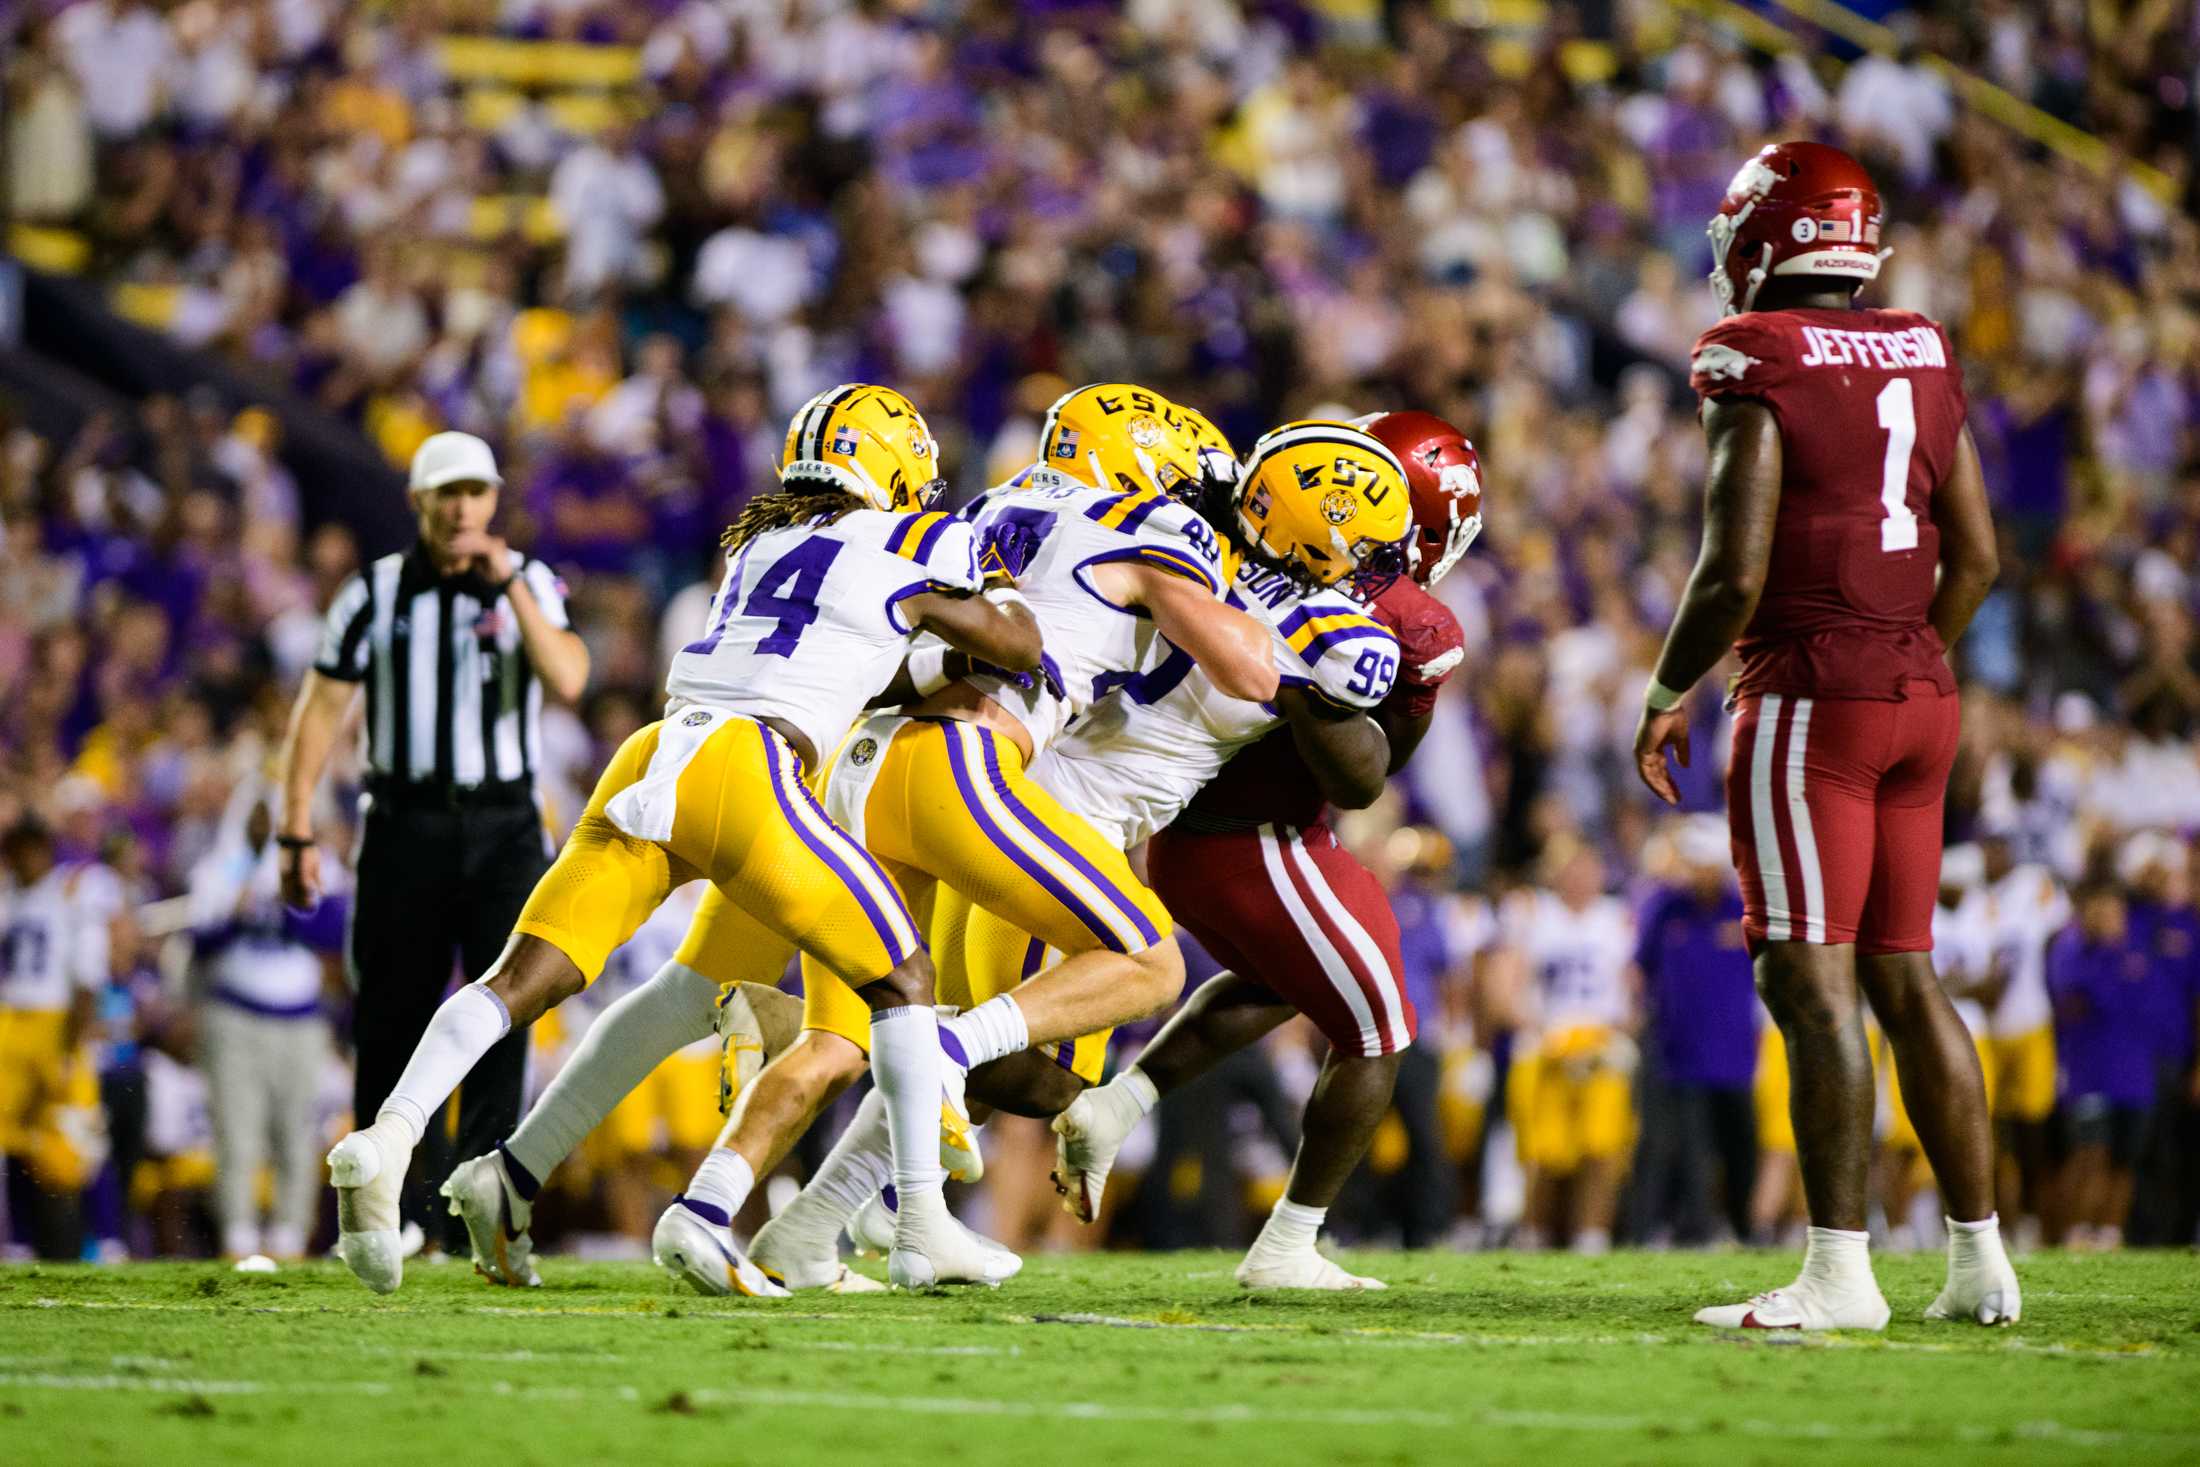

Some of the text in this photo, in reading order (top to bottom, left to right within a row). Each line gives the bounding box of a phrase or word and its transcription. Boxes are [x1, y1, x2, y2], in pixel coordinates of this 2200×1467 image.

[1800, 222, 1809, 239] 3
[1801, 326, 1947, 370] JEFFERSON
[1031, 472, 1061, 486] ERS
[1293, 456, 1391, 507] LSU
[1876, 377, 1919, 552] 1
[681, 534, 845, 660] 14
[1346, 647, 1395, 699] 99
